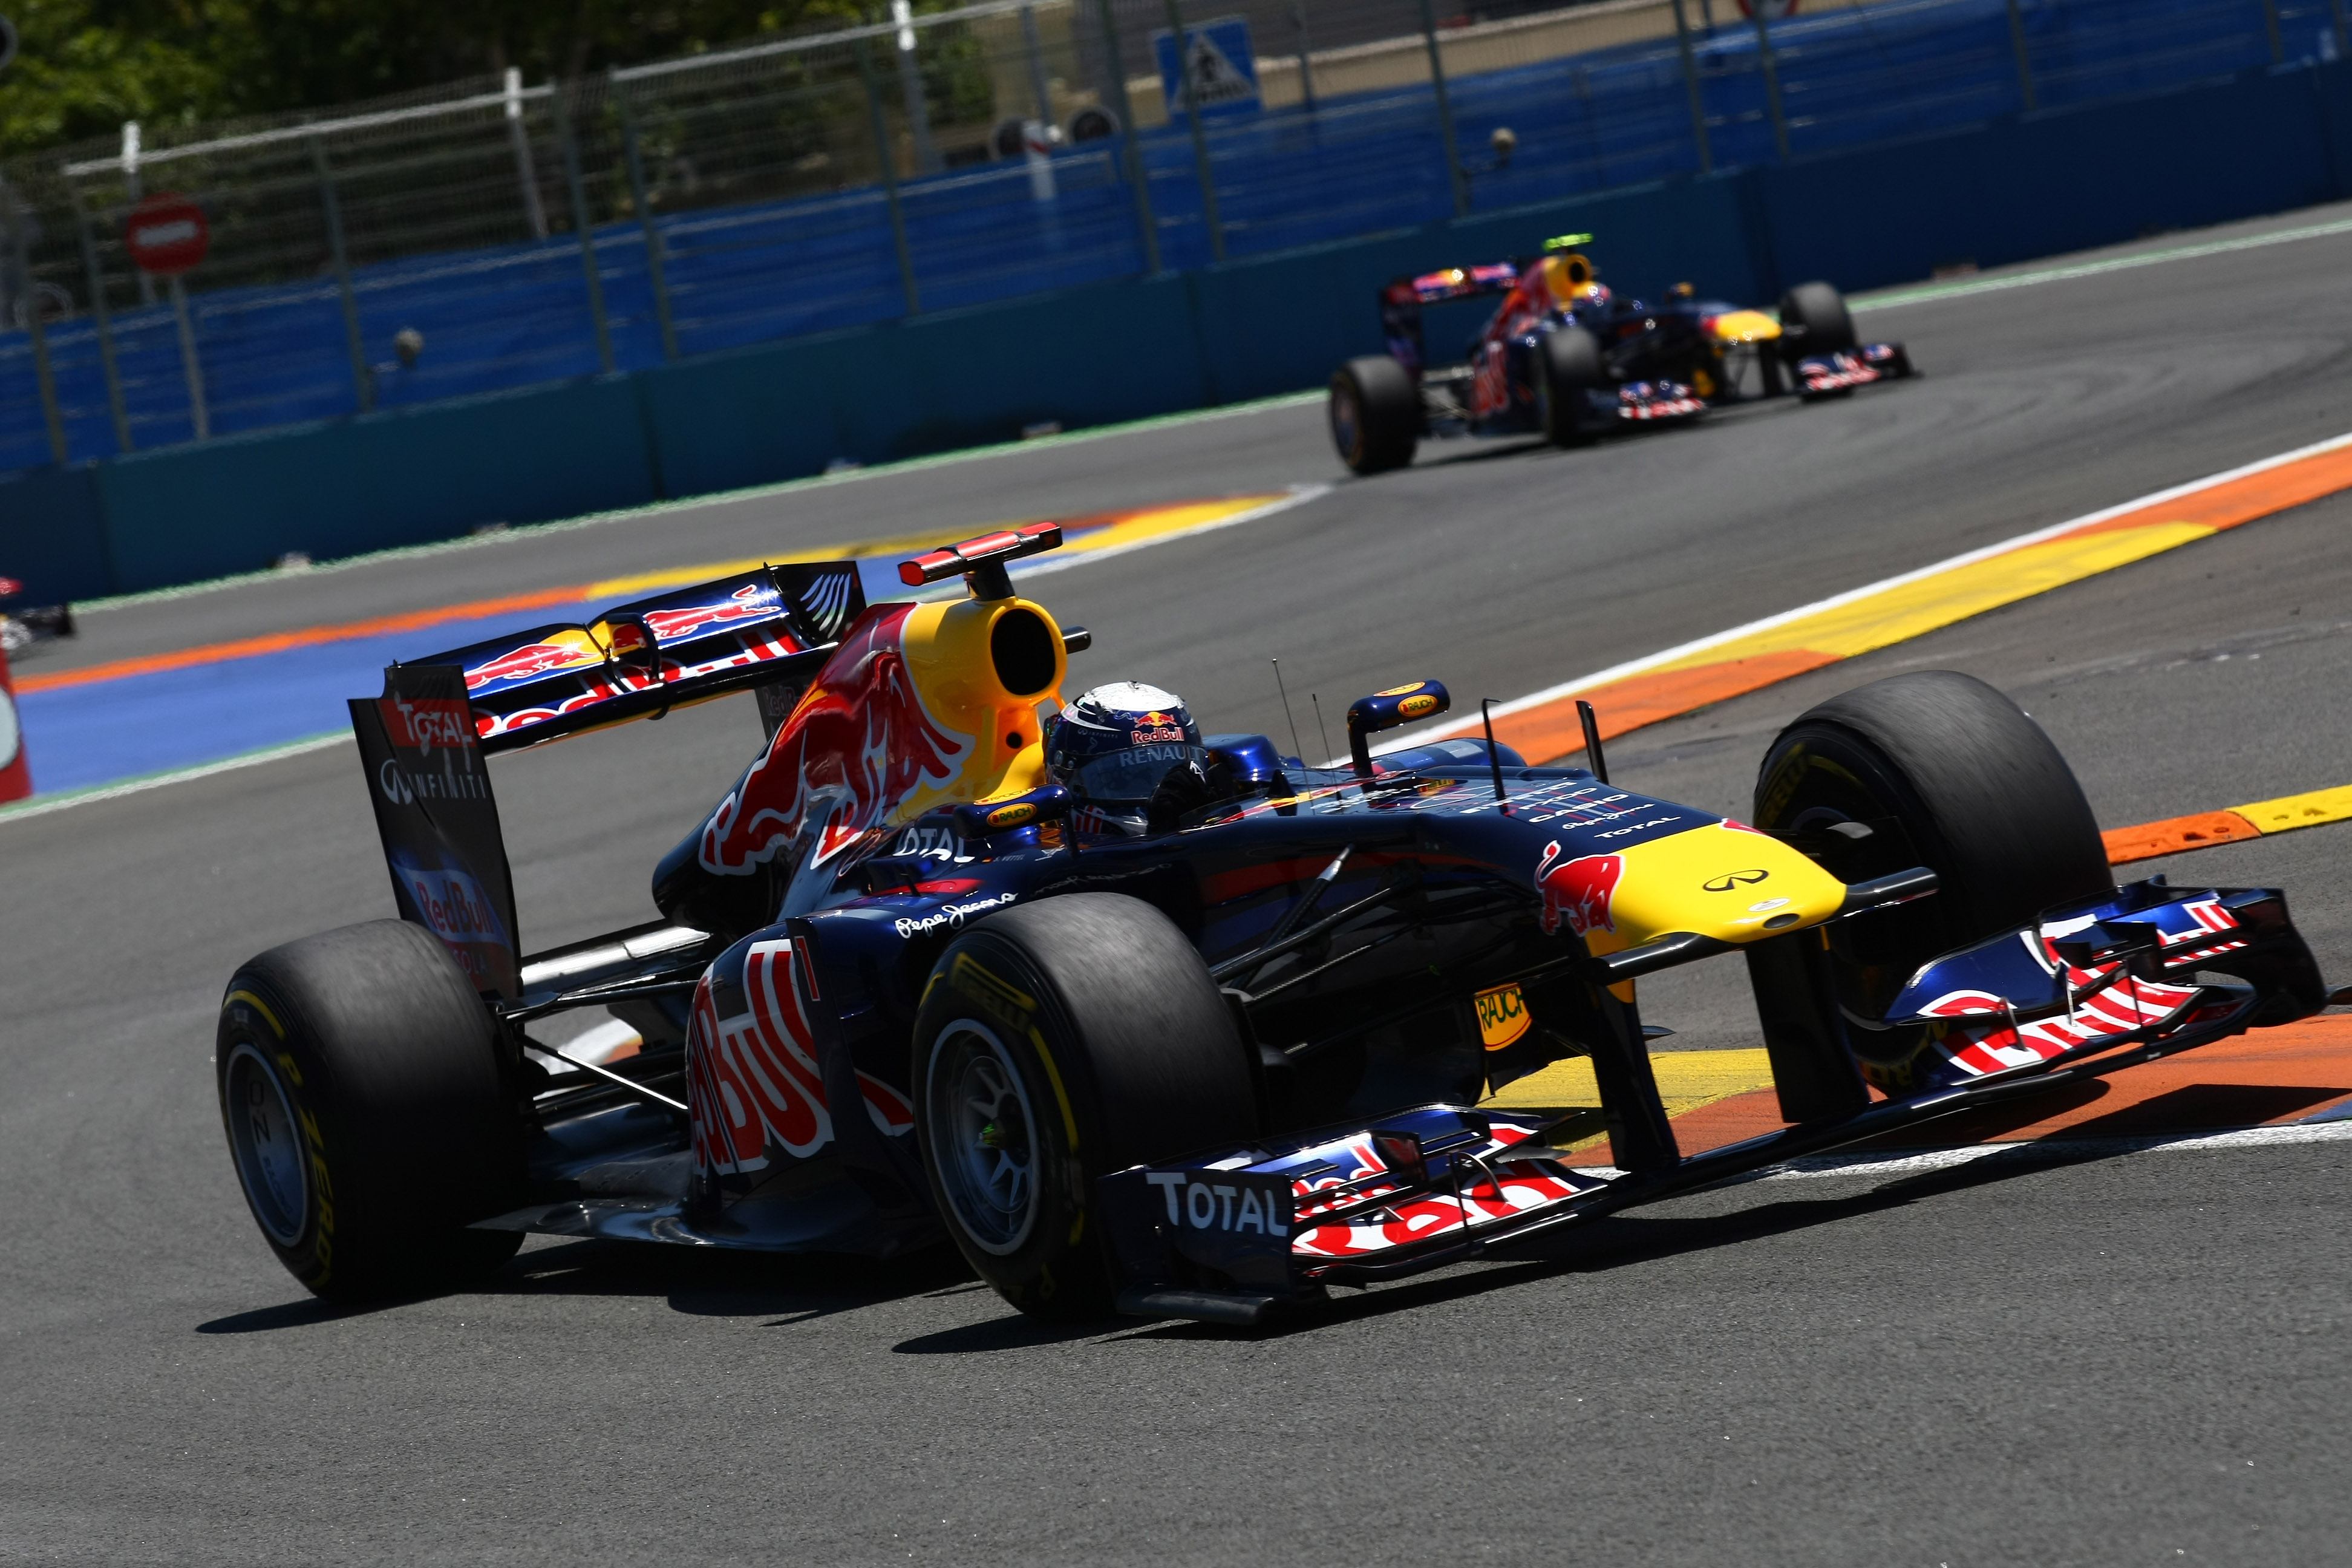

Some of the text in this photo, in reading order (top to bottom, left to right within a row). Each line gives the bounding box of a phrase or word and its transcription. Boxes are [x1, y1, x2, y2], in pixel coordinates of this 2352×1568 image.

[1408, 699, 1432, 711] RAUCH
[397, 703, 473, 743] TOTAL
[1131, 727, 1185, 745] Red Bull
[1119, 745, 1201, 768] RENAULT
[1000, 806, 1031, 822] RAUCH
[1529, 794, 1629, 823] CASIO
[1593, 816, 1682, 838] TOTAL
[416, 880, 494, 934] Red Bull
[895, 892, 1019, 939] Pepe Jeans
[278, 1051, 335, 1271] P ZERO
[1146, 1172, 1289, 1237] TOTAL
